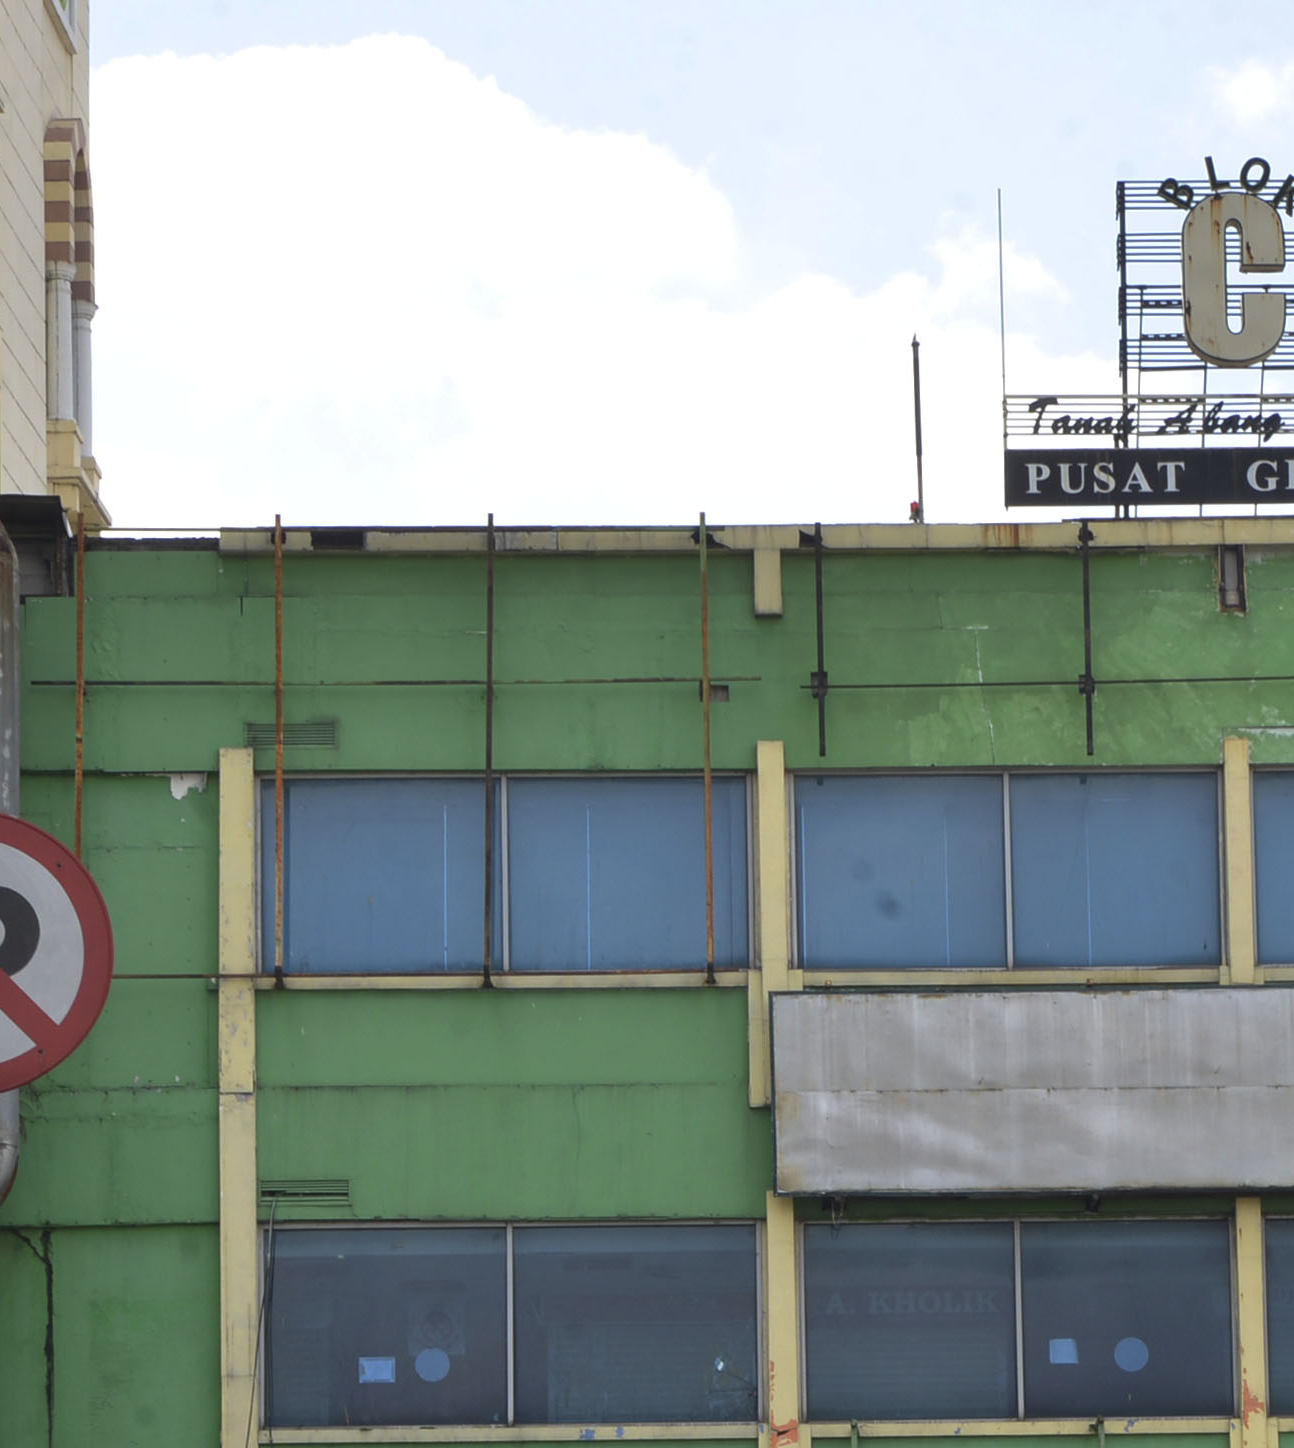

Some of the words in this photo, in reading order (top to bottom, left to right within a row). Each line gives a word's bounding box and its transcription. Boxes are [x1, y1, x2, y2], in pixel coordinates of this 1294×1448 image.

[1181, 191, 1287, 368] C
[1028, 396, 1137, 436] Tanah
[1157, 401, 1286, 442] Abang
[1025, 461, 1186, 494] PUSAT
